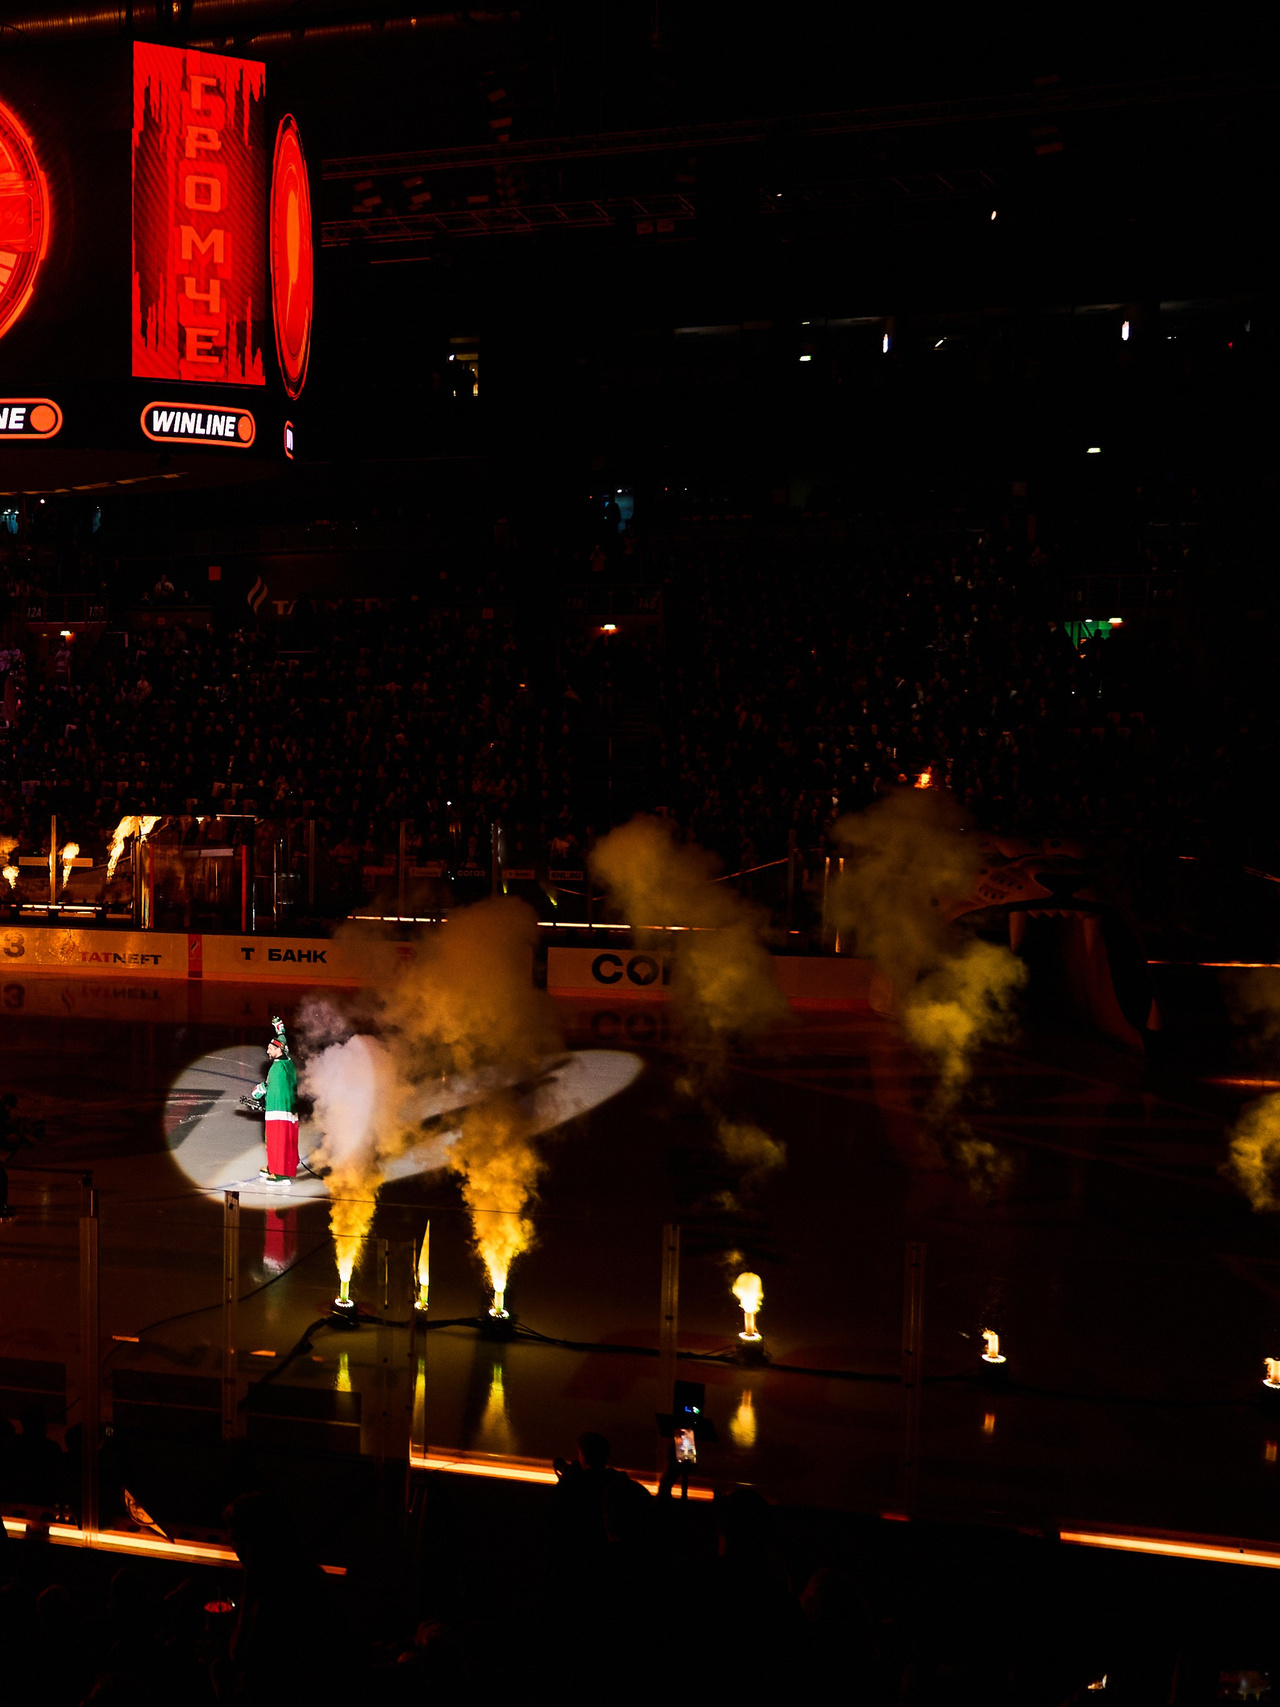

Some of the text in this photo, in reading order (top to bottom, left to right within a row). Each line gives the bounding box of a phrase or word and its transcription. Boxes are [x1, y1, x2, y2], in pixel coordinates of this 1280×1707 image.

[180, 75, 225, 364] ГРОМЧЕ
[153, 410, 236, 437] WINLINE
[81, 951, 162, 965] TATNEFT
[268, 948, 327, 963] БАНК
